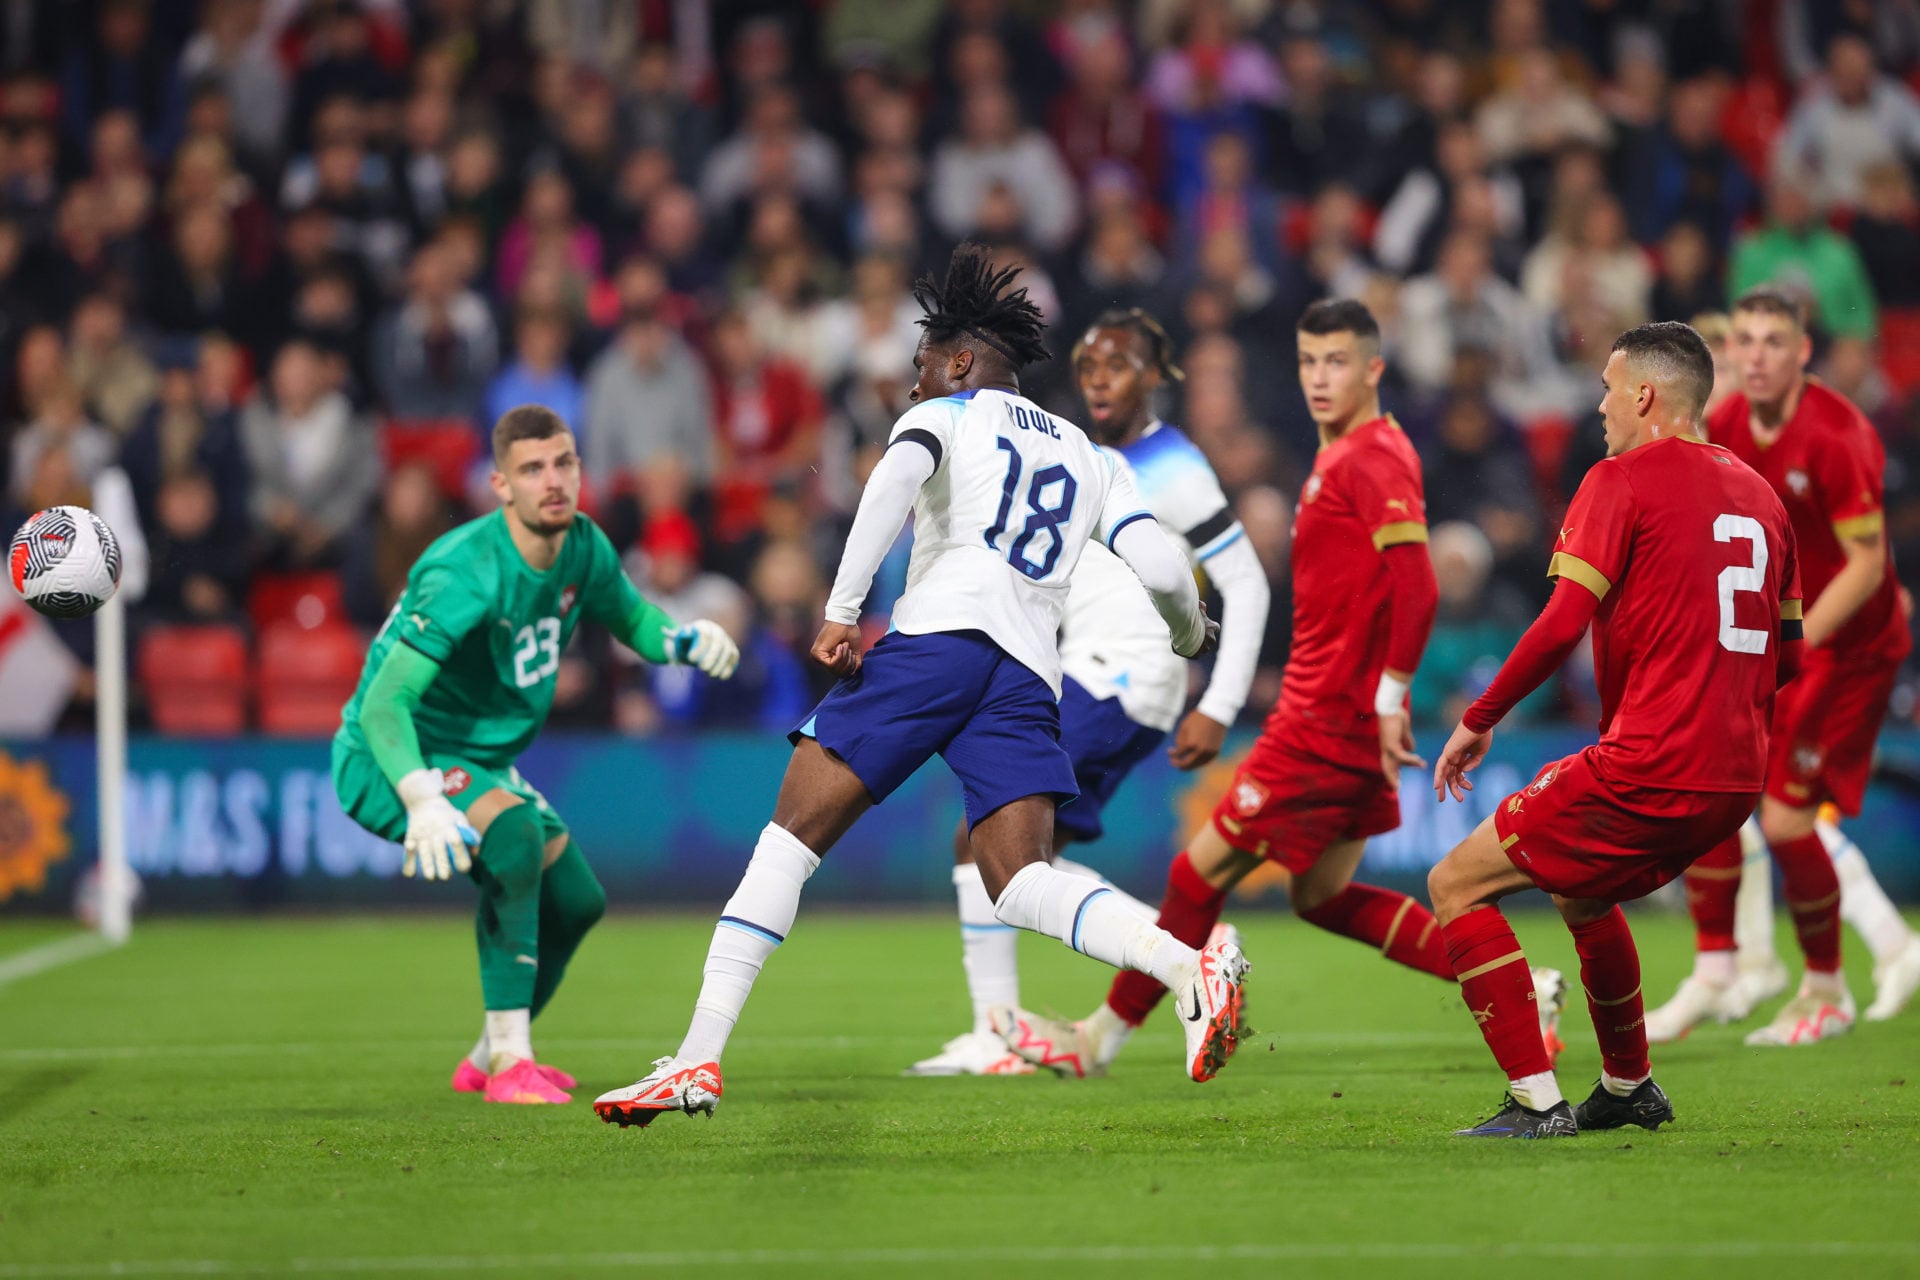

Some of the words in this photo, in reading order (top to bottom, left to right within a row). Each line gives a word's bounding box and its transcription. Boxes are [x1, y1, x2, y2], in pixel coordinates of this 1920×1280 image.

[984, 434, 1078, 581] 18
[514, 616, 561, 688] 23
[1713, 513, 1769, 655] 2
